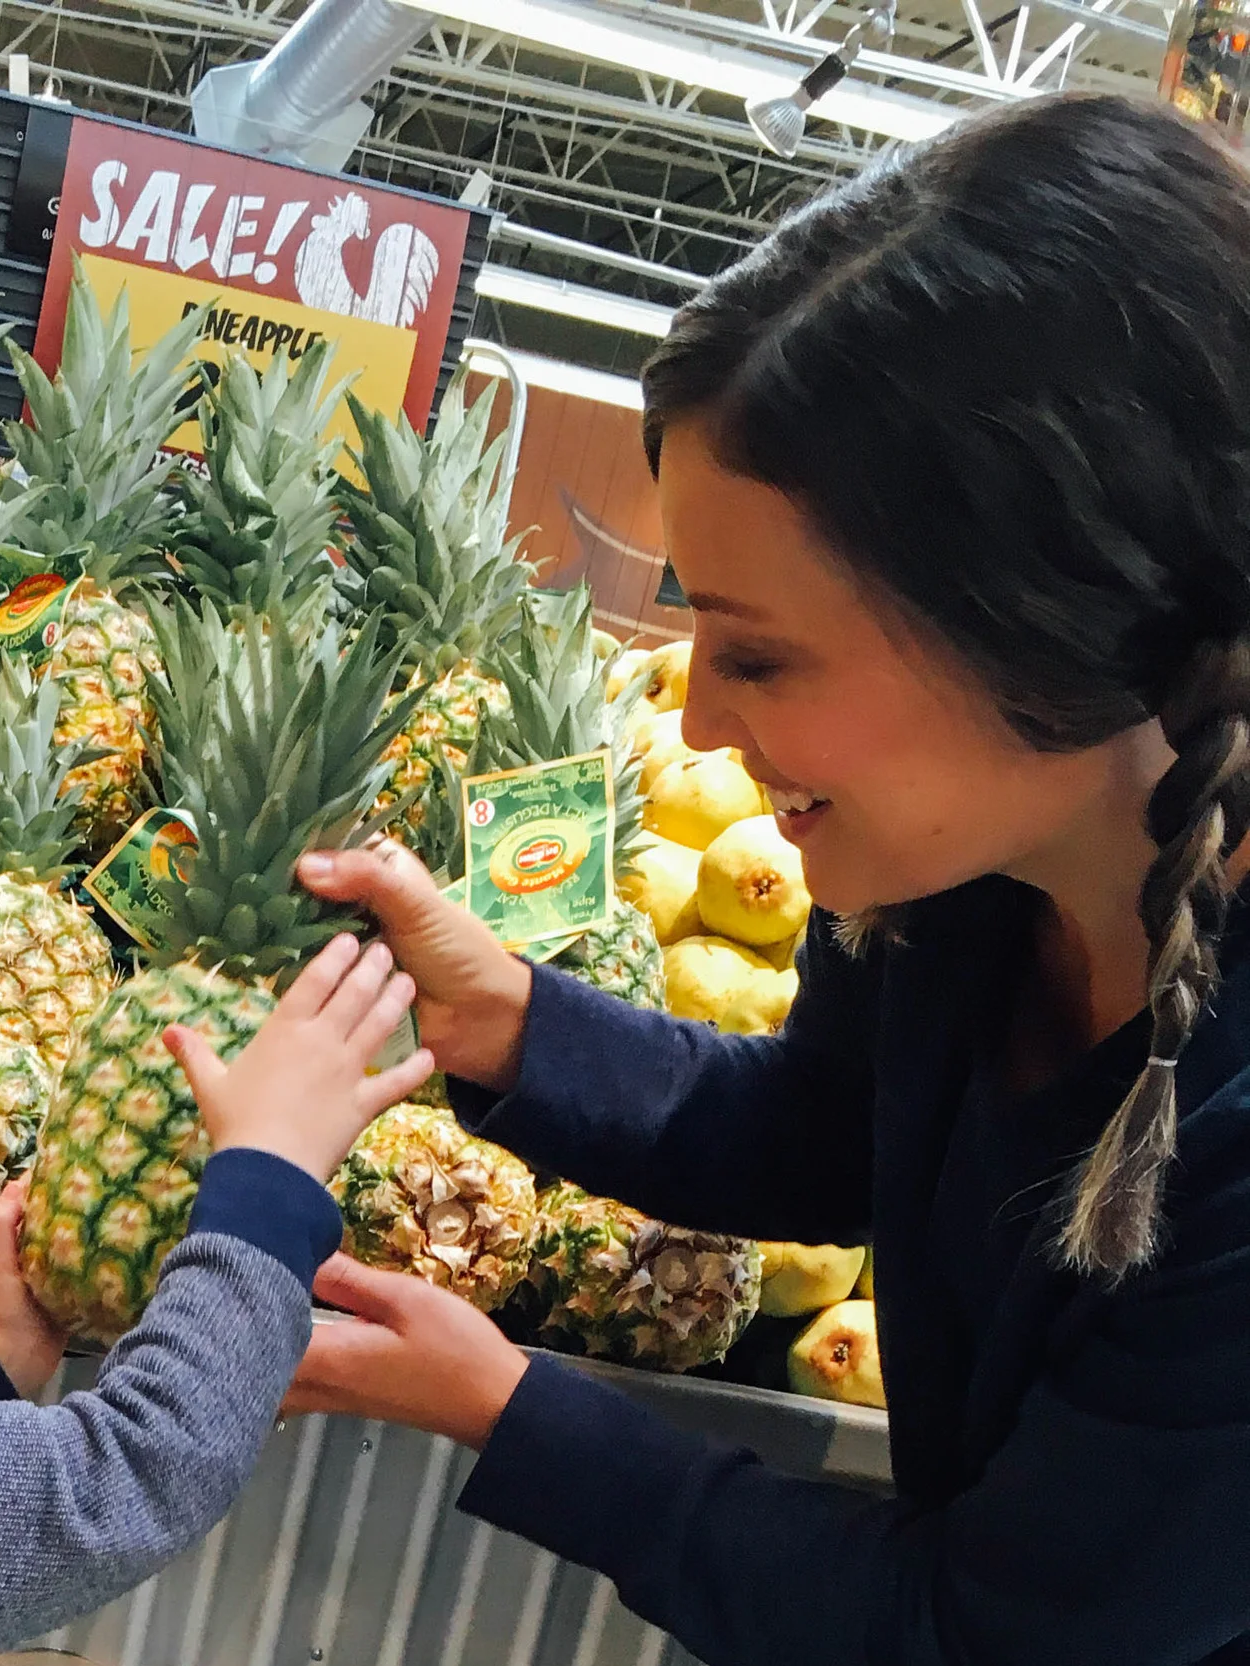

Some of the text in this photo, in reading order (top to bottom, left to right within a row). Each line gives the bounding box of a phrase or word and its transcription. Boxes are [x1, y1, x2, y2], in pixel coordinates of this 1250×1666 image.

[79, 159, 310, 286] SALE!
[182, 301, 324, 361] NEAPPL
[475, 801, 488, 824] 8
